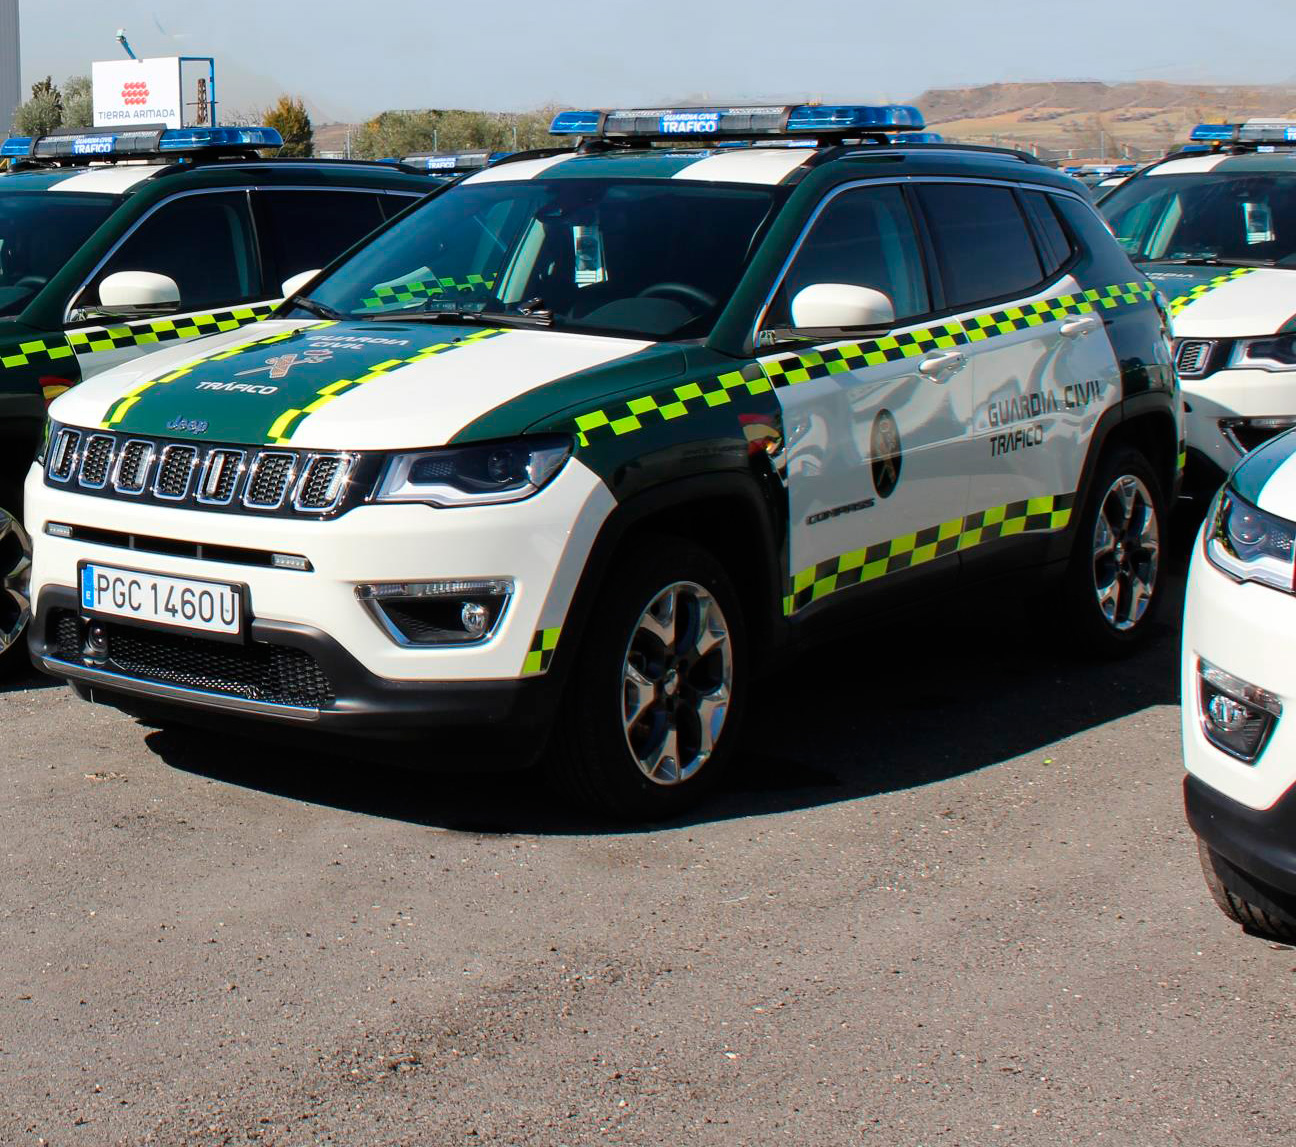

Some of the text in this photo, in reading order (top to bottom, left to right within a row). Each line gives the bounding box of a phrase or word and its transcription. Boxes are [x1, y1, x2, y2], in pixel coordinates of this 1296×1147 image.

[133, 109, 176, 119] ARMADA
[306, 335, 409, 346] GUARDIA
[308, 341, 364, 350] CIVIL
[988, 379, 1102, 428] GUARDIA CIVIL
[166, 414, 209, 435] Jeep
